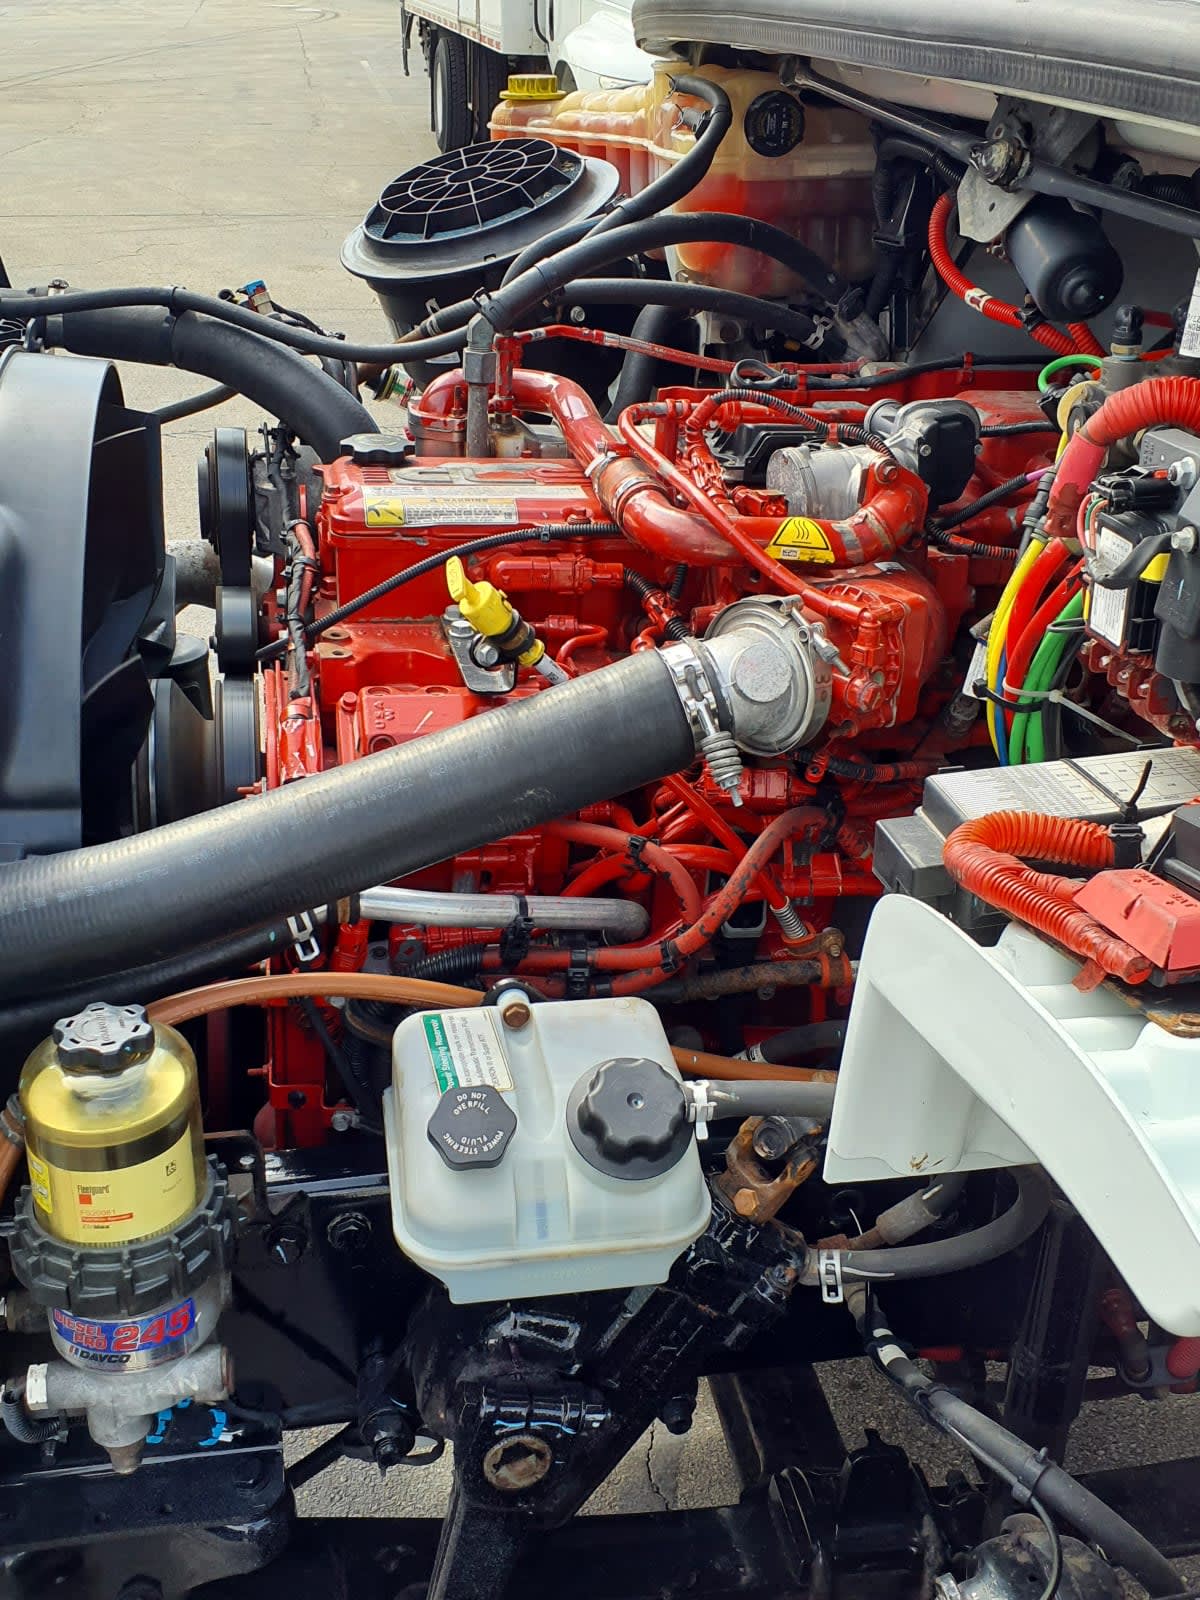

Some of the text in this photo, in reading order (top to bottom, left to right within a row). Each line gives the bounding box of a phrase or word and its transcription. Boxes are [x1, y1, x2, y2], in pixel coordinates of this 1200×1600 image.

[374, 700, 386, 730] USA
[431, 1018, 444, 1047] Reservoir
[438, 1046, 451, 1072] Steering
[453, 1101, 490, 1115] OVERFILL
[457, 1092, 487, 1102] DO NOT
[443, 1130, 505, 1155] POWER STEERING
[77, 1184, 110, 1195] Fleetguard
[54, 1308, 106, 1337] DIESEL
[111, 1302, 191, 1352] 245
[73, 1332, 107, 1350] PRO
[80, 1350, 131, 1363] DAVCO
